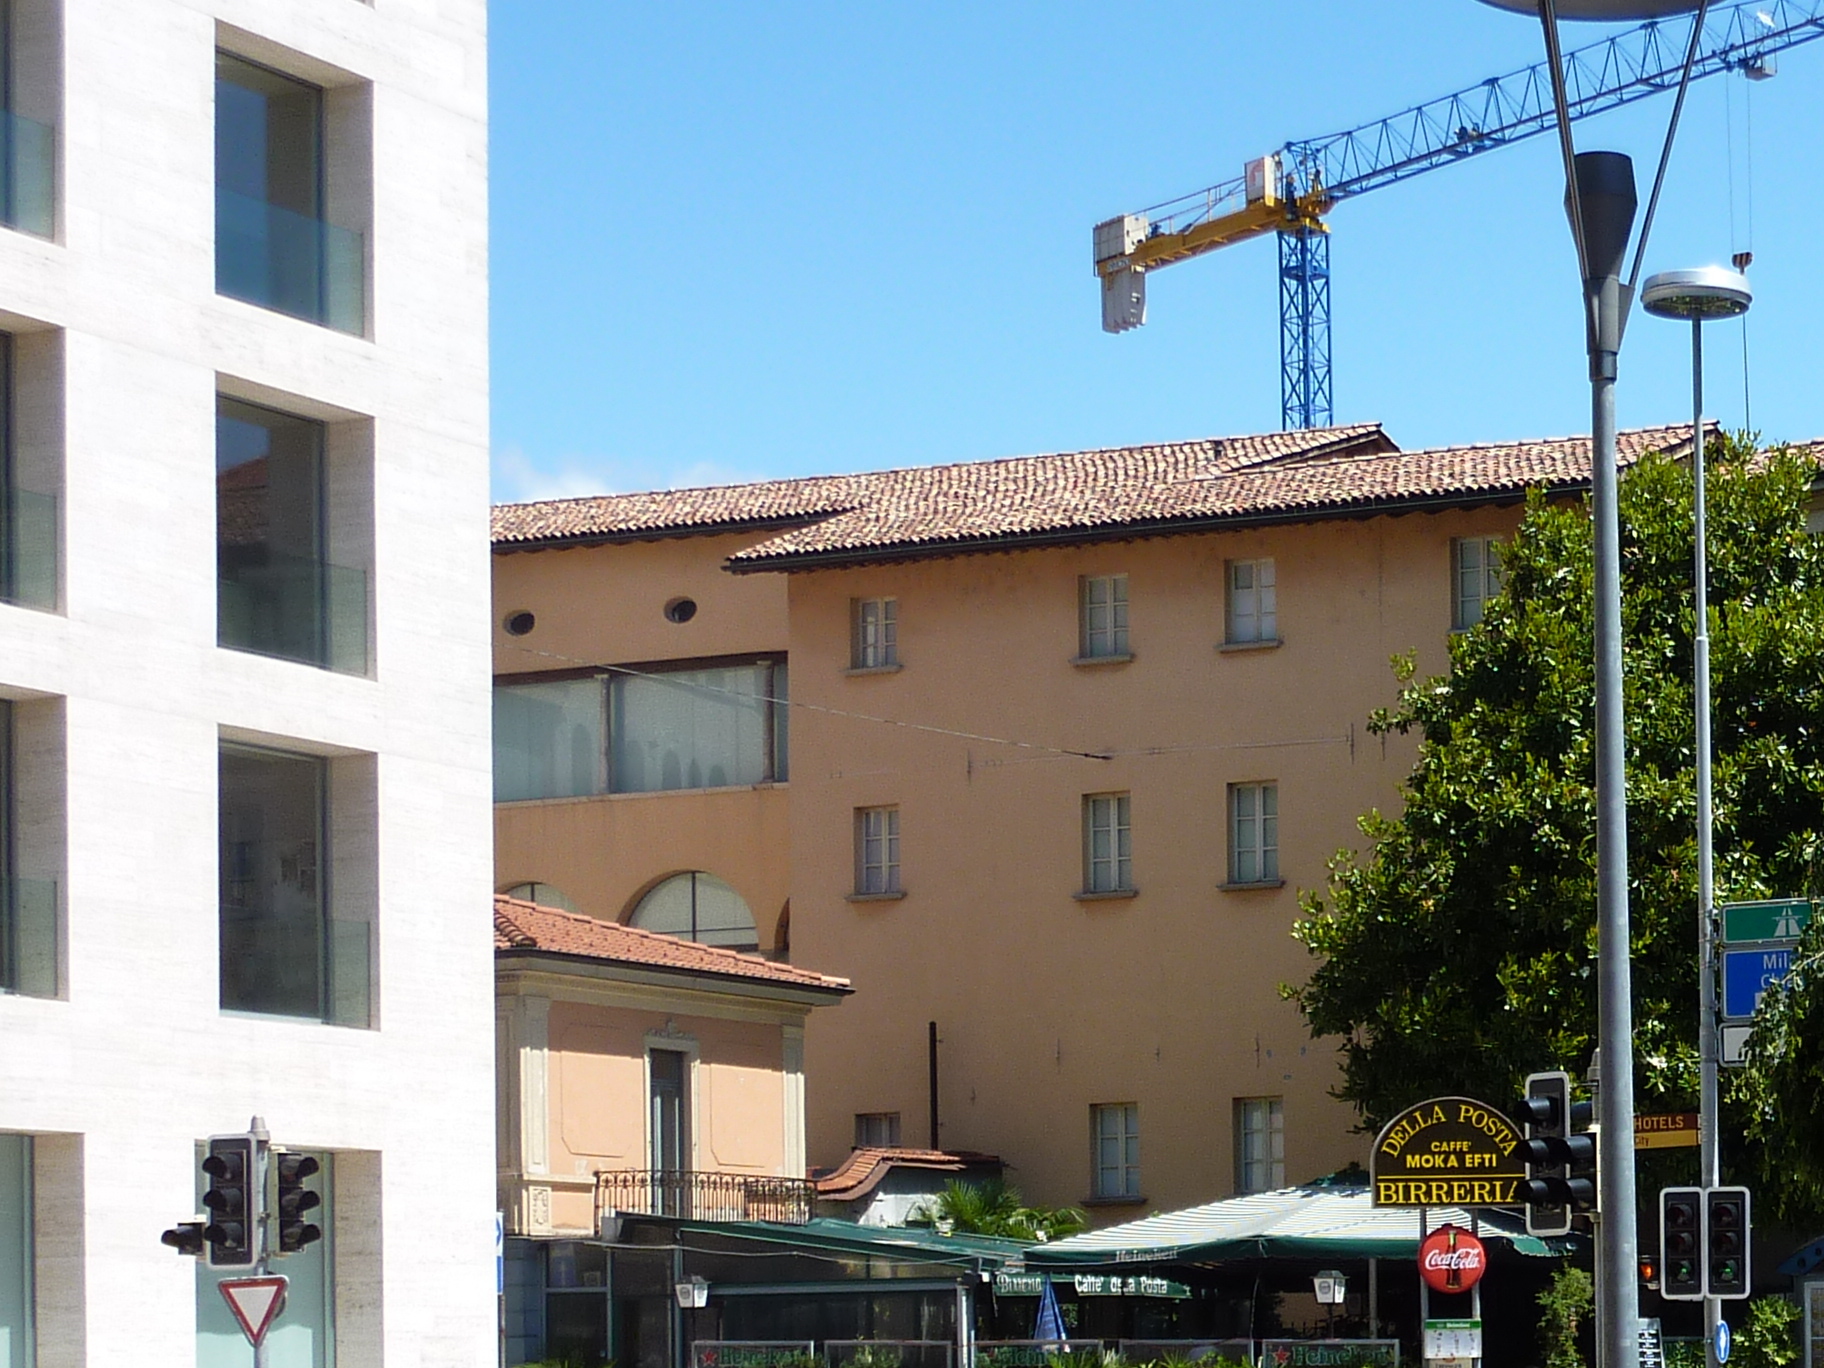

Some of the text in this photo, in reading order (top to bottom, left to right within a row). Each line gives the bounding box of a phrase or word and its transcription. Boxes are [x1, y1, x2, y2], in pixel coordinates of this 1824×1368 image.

[1634, 1115, 1684, 1130] HOTELS
[1381, 1104, 1518, 1158] DELLA POSTA
[1430, 1141, 1472, 1153] CAFFE'
[1406, 1153, 1497, 1168] MOKA EFTI
[1115, 1246, 1178, 1263] Heineken
[1140, 1276, 1168, 1294] Posta
